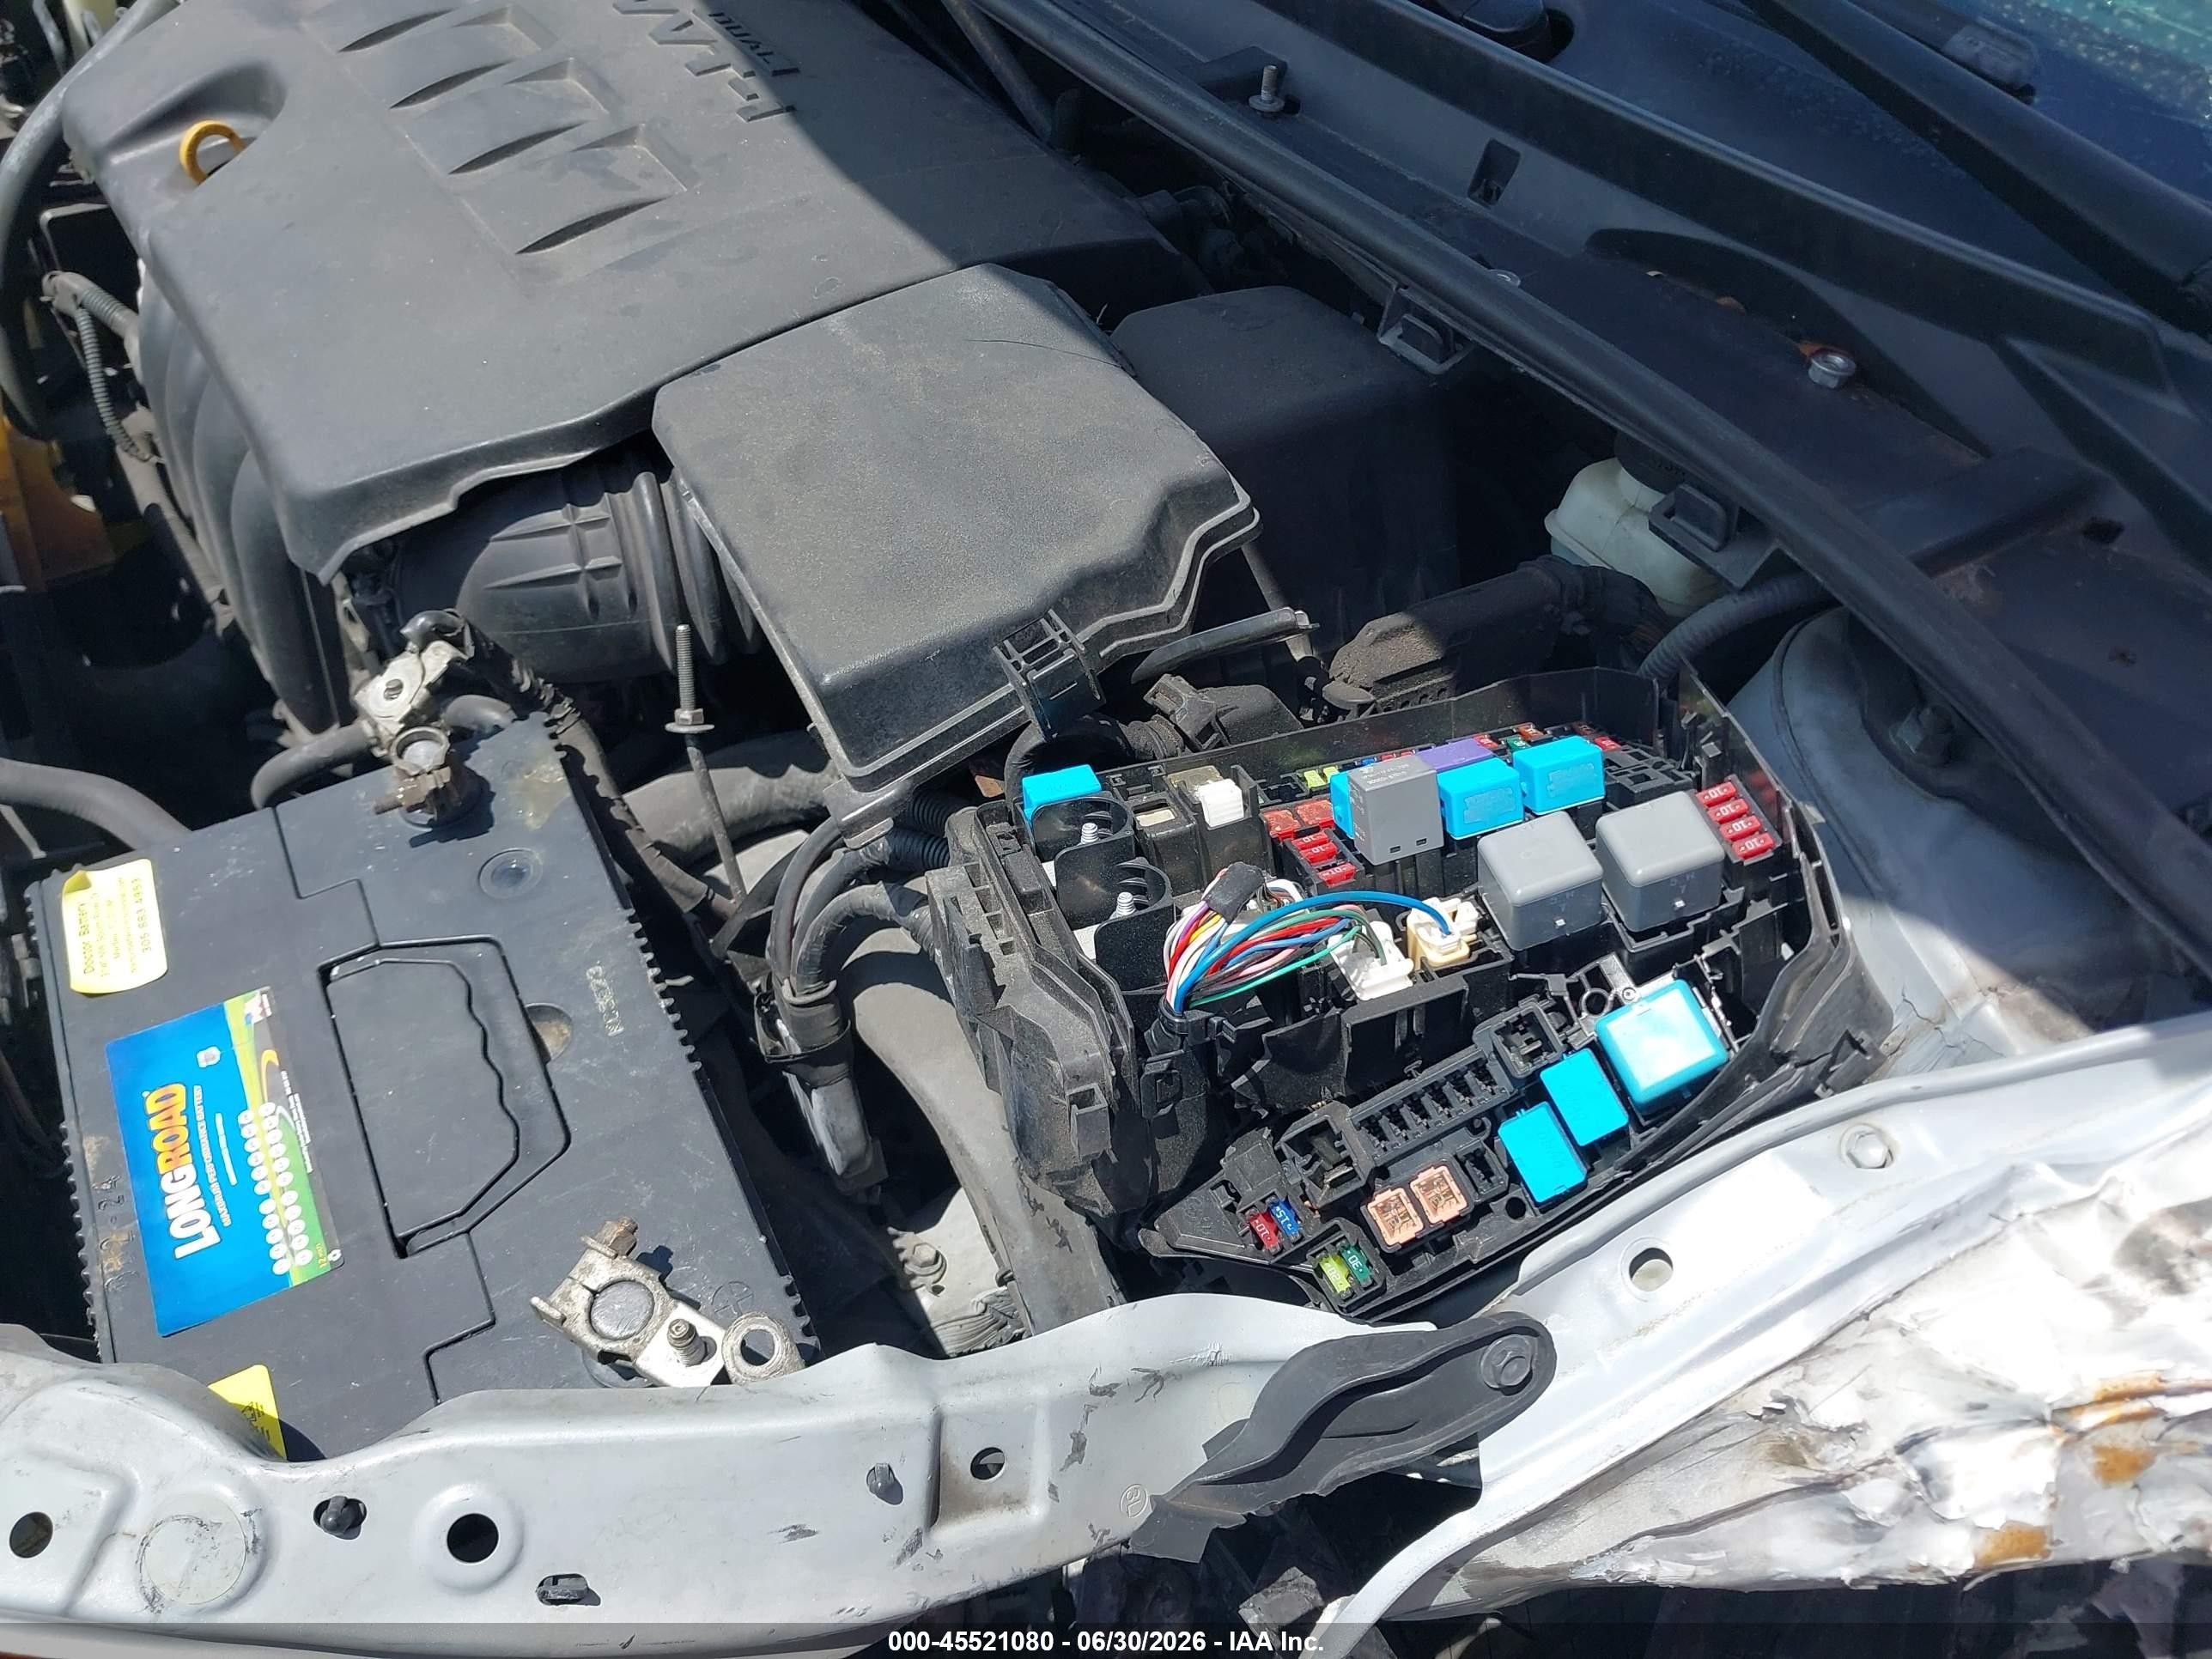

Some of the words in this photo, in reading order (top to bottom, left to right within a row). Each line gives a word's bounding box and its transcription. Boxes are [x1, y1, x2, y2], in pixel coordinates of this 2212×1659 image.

[1708, 787, 1723, 799] 10
[1719, 804, 1735, 815] 10
[1732, 820, 1747, 831] 10
[1745, 838, 1759, 849] 10
[144, 1083, 222, 1259] LONGROAD
[1275, 1208, 1289, 1224] 15
[1255, 1223, 1269, 1237] 10
[1348, 1255, 1362, 1269] 30
